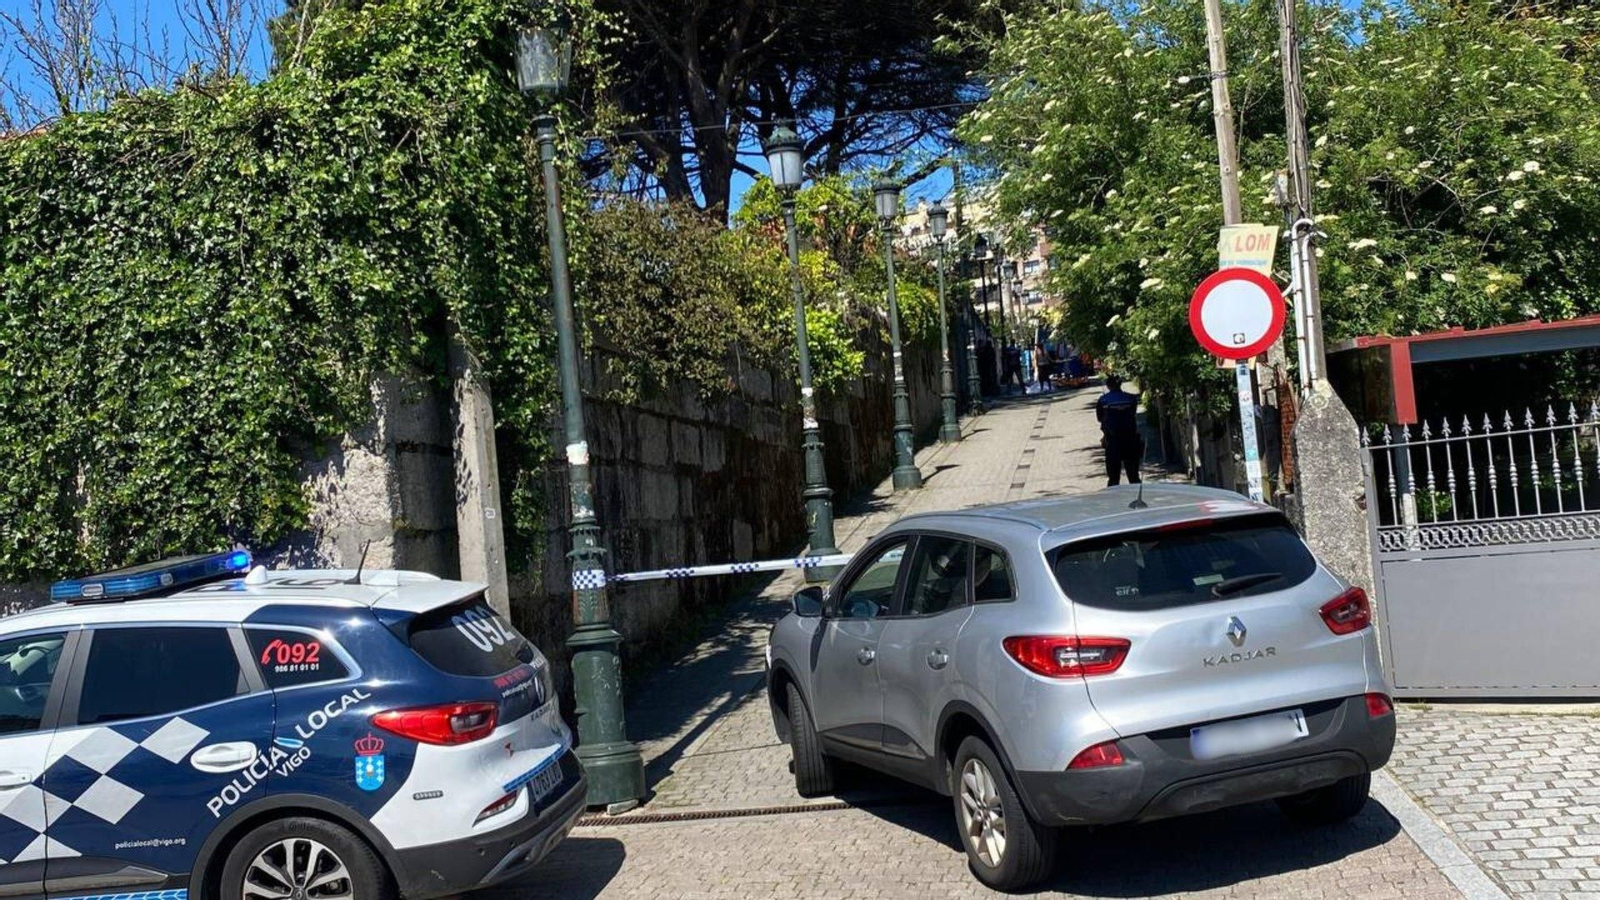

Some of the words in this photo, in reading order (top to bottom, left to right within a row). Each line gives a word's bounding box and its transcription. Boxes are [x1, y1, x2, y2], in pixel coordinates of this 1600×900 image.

[451, 605, 516, 652] 092
[277, 642, 320, 665] 092
[1203, 646, 1277, 668] KADJAR
[289, 664, 299, 673] 81
[300, 663, 309, 672] 01
[310, 663, 320, 672] 01
[206, 745, 289, 819] POLICÍA
[294, 688, 372, 740] LOCAL
[275, 746, 312, 778] VIGO
[114, 838, 187, 850] policialocal@vigo.org
